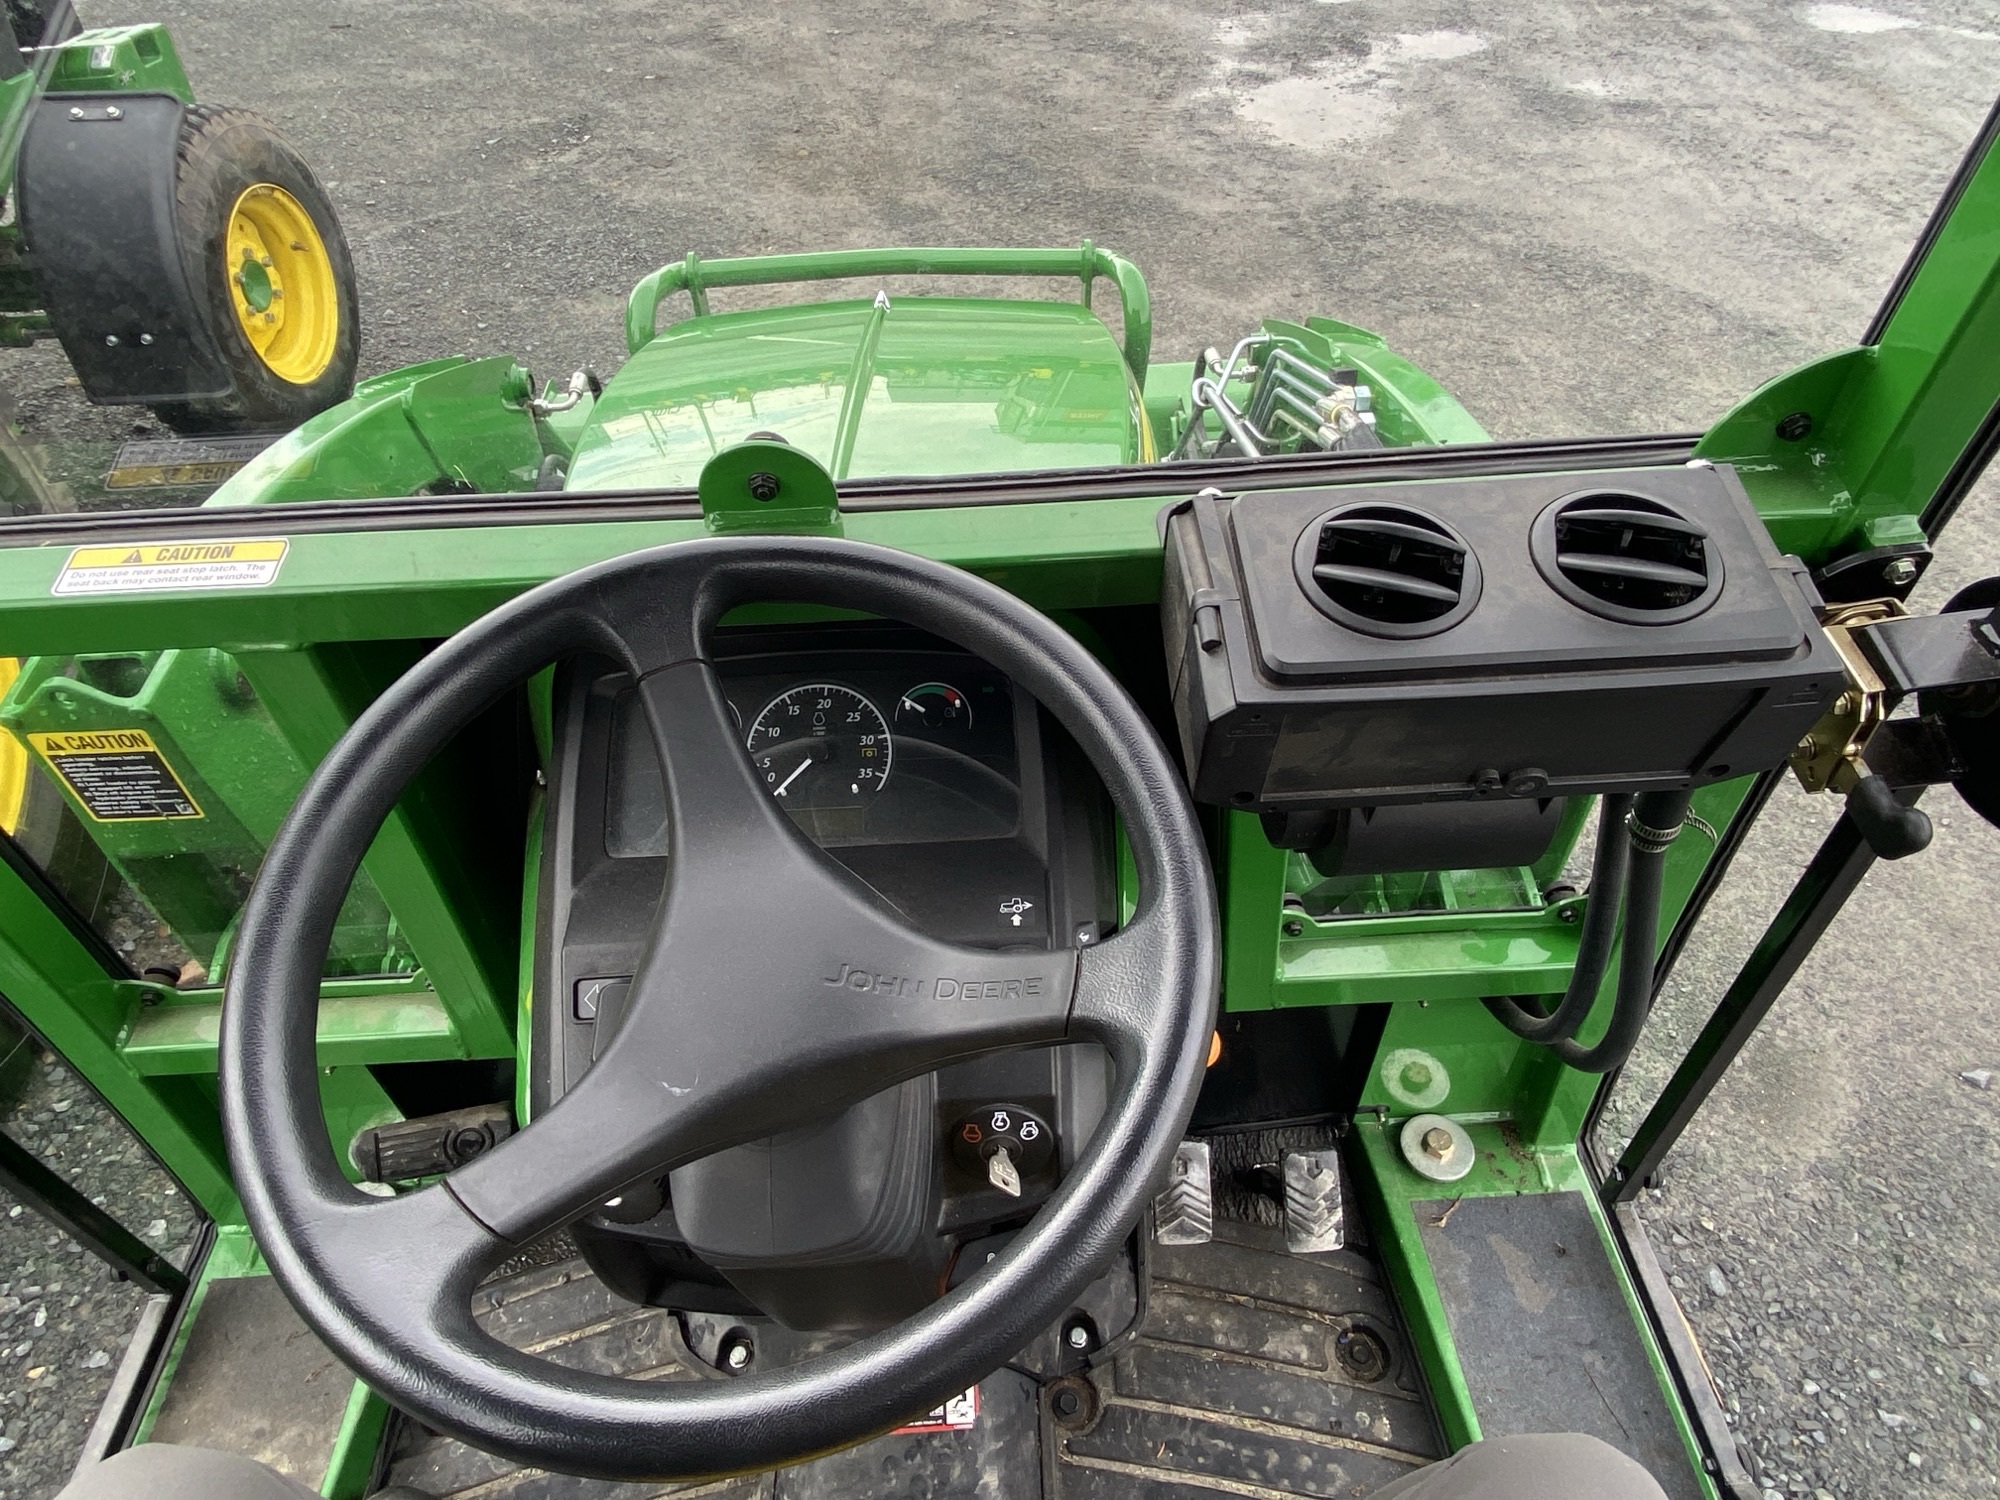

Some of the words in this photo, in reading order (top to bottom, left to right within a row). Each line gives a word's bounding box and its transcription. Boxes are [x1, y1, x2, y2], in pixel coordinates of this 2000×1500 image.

[155, 545, 236, 562] CAUTION
[70, 571, 86, 579] Do
[88, 570, 108, 578] not
[109, 569, 130, 577] use
[132, 568, 154, 576] rear
[156, 567, 180, 575] seat
[182, 565, 207, 576] stop
[209, 564, 239, 573] latch.
[246, 563, 266, 571] The
[66, 579, 91, 588] seat
[93, 578, 119, 586] back
[121, 577, 145, 586] may
[148, 574, 189, 584] contact
[216, 571, 261, 581] window.
[816, 699, 832, 709] 20
[788, 705, 800, 716] 15
[846, 712, 861, 722] 25
[767, 727, 780, 738] 10
[64, 733, 149, 750] CAUTION
[859, 735, 875, 745] 30
[762, 757, 771, 768] 5
[767, 772, 776, 782] 0
[858, 768, 873, 779] 35
[824, 963, 924, 998] JOHN
[933, 977, 1043, 1000] DEERE
